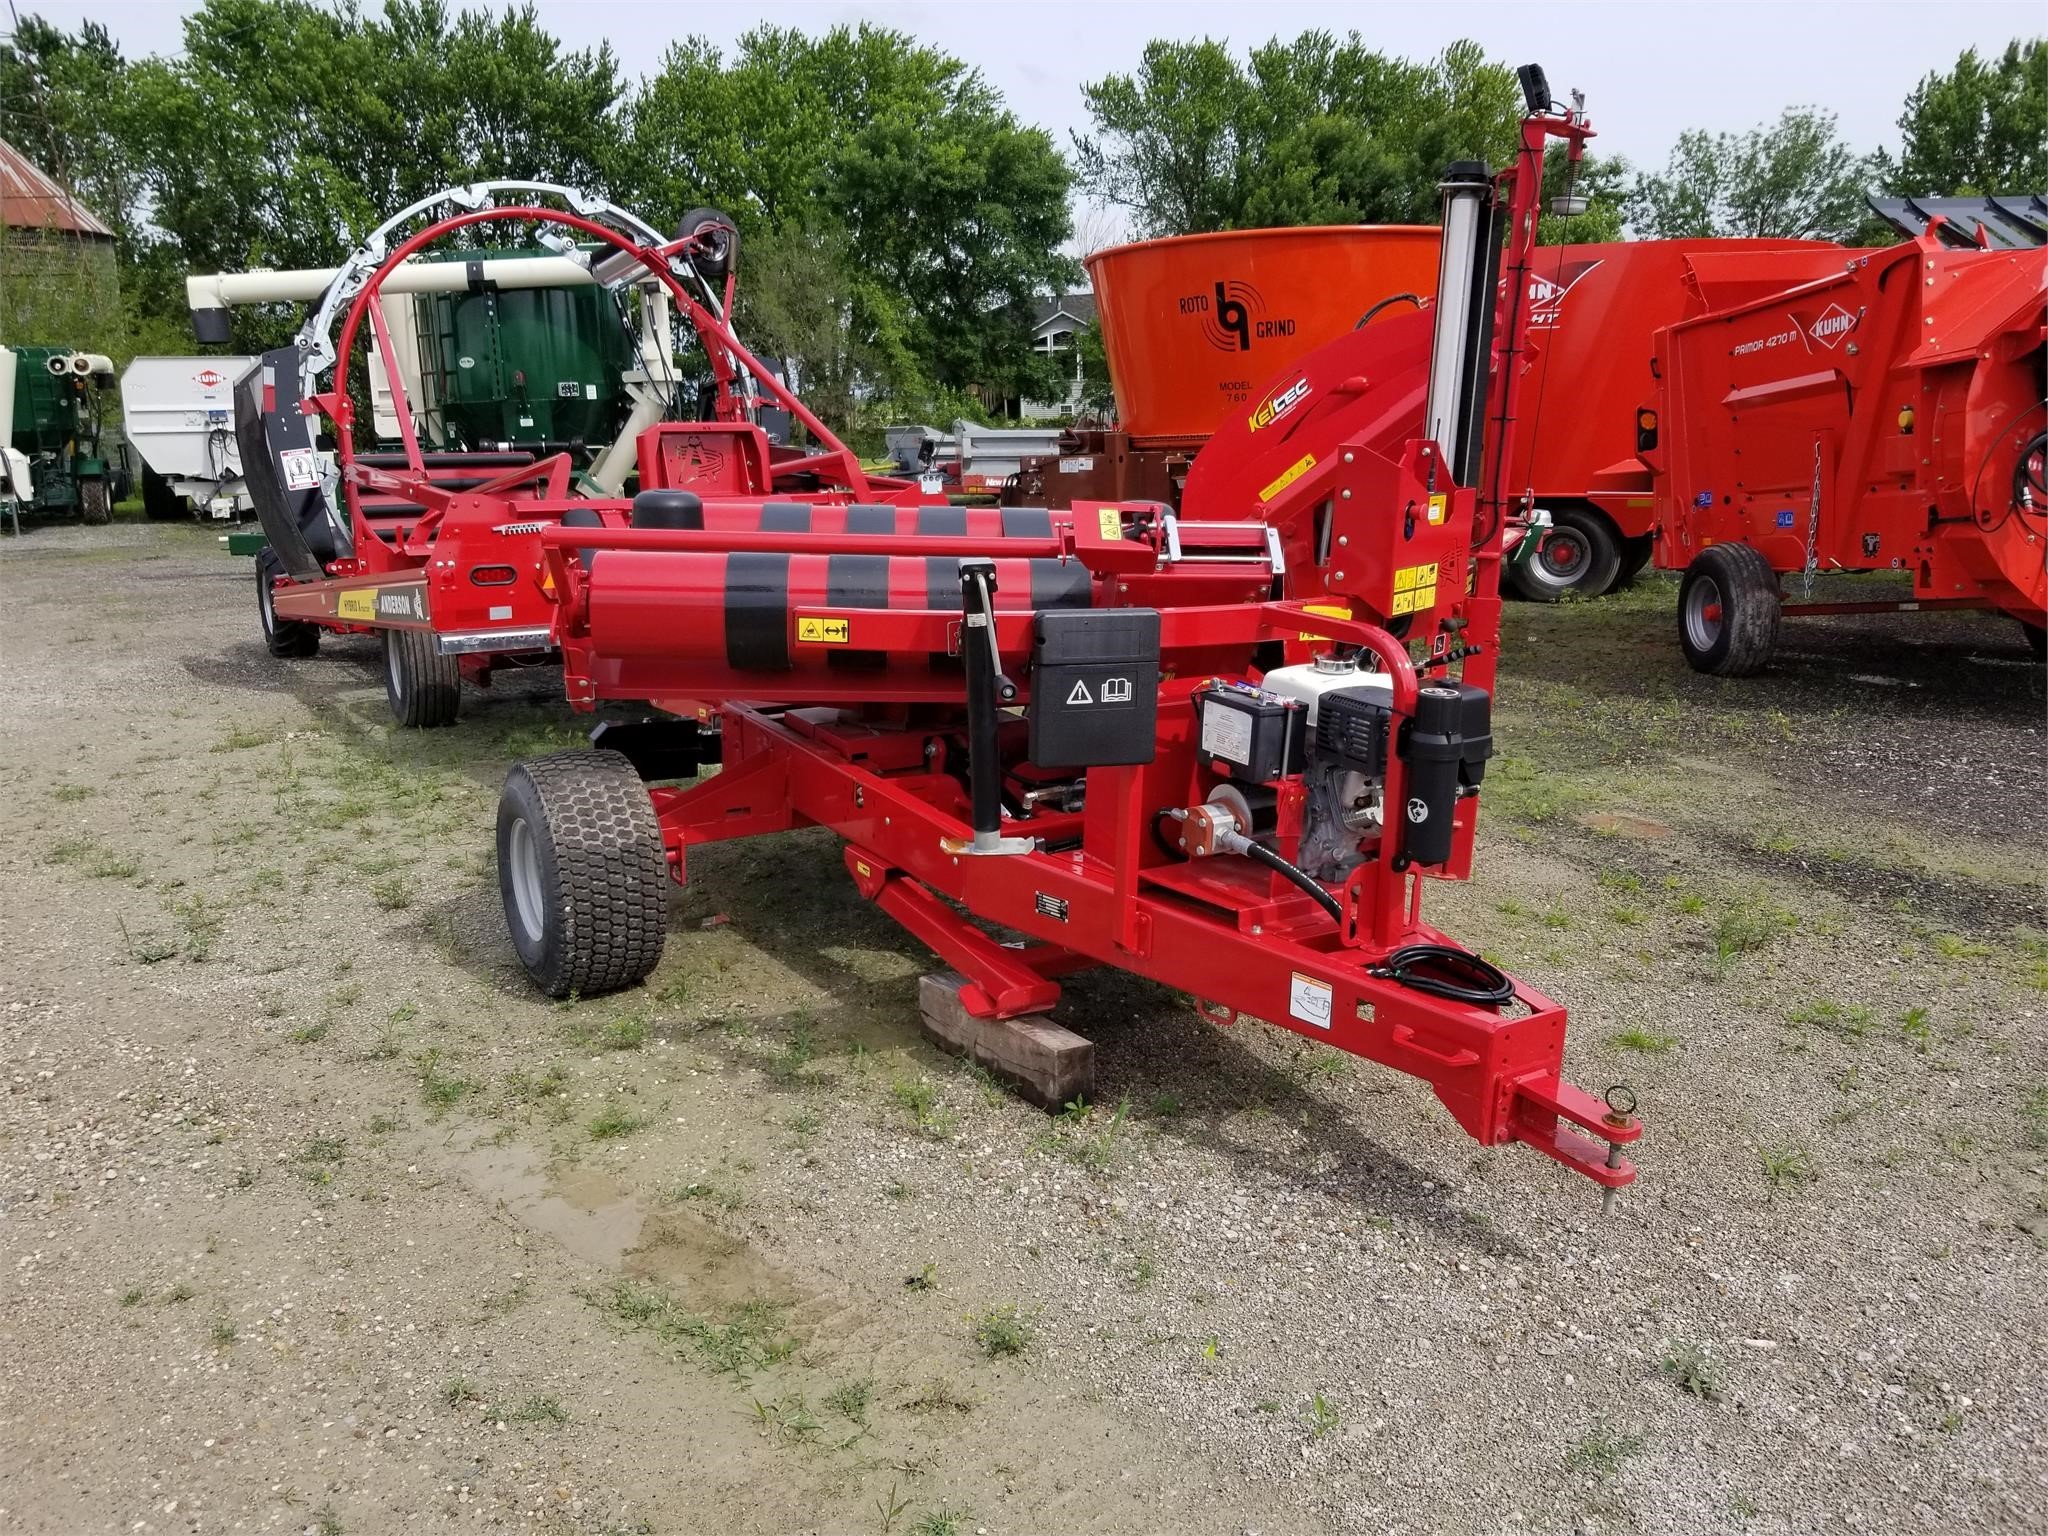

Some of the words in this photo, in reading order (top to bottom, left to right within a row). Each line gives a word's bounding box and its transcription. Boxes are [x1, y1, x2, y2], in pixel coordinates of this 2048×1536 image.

[1179, 295, 1209, 315] ROTO
[1256, 319, 1296, 338] GRIND
[1815, 314, 1850, 337] KUHN
[1734, 339, 1764, 356] PRIMOR
[1765, 332, 1788, 348] 4270
[192, 374, 224, 383] KUHN
[1219, 382, 1252, 391] MODEL
[381, 595, 411, 615] ANDERSON
